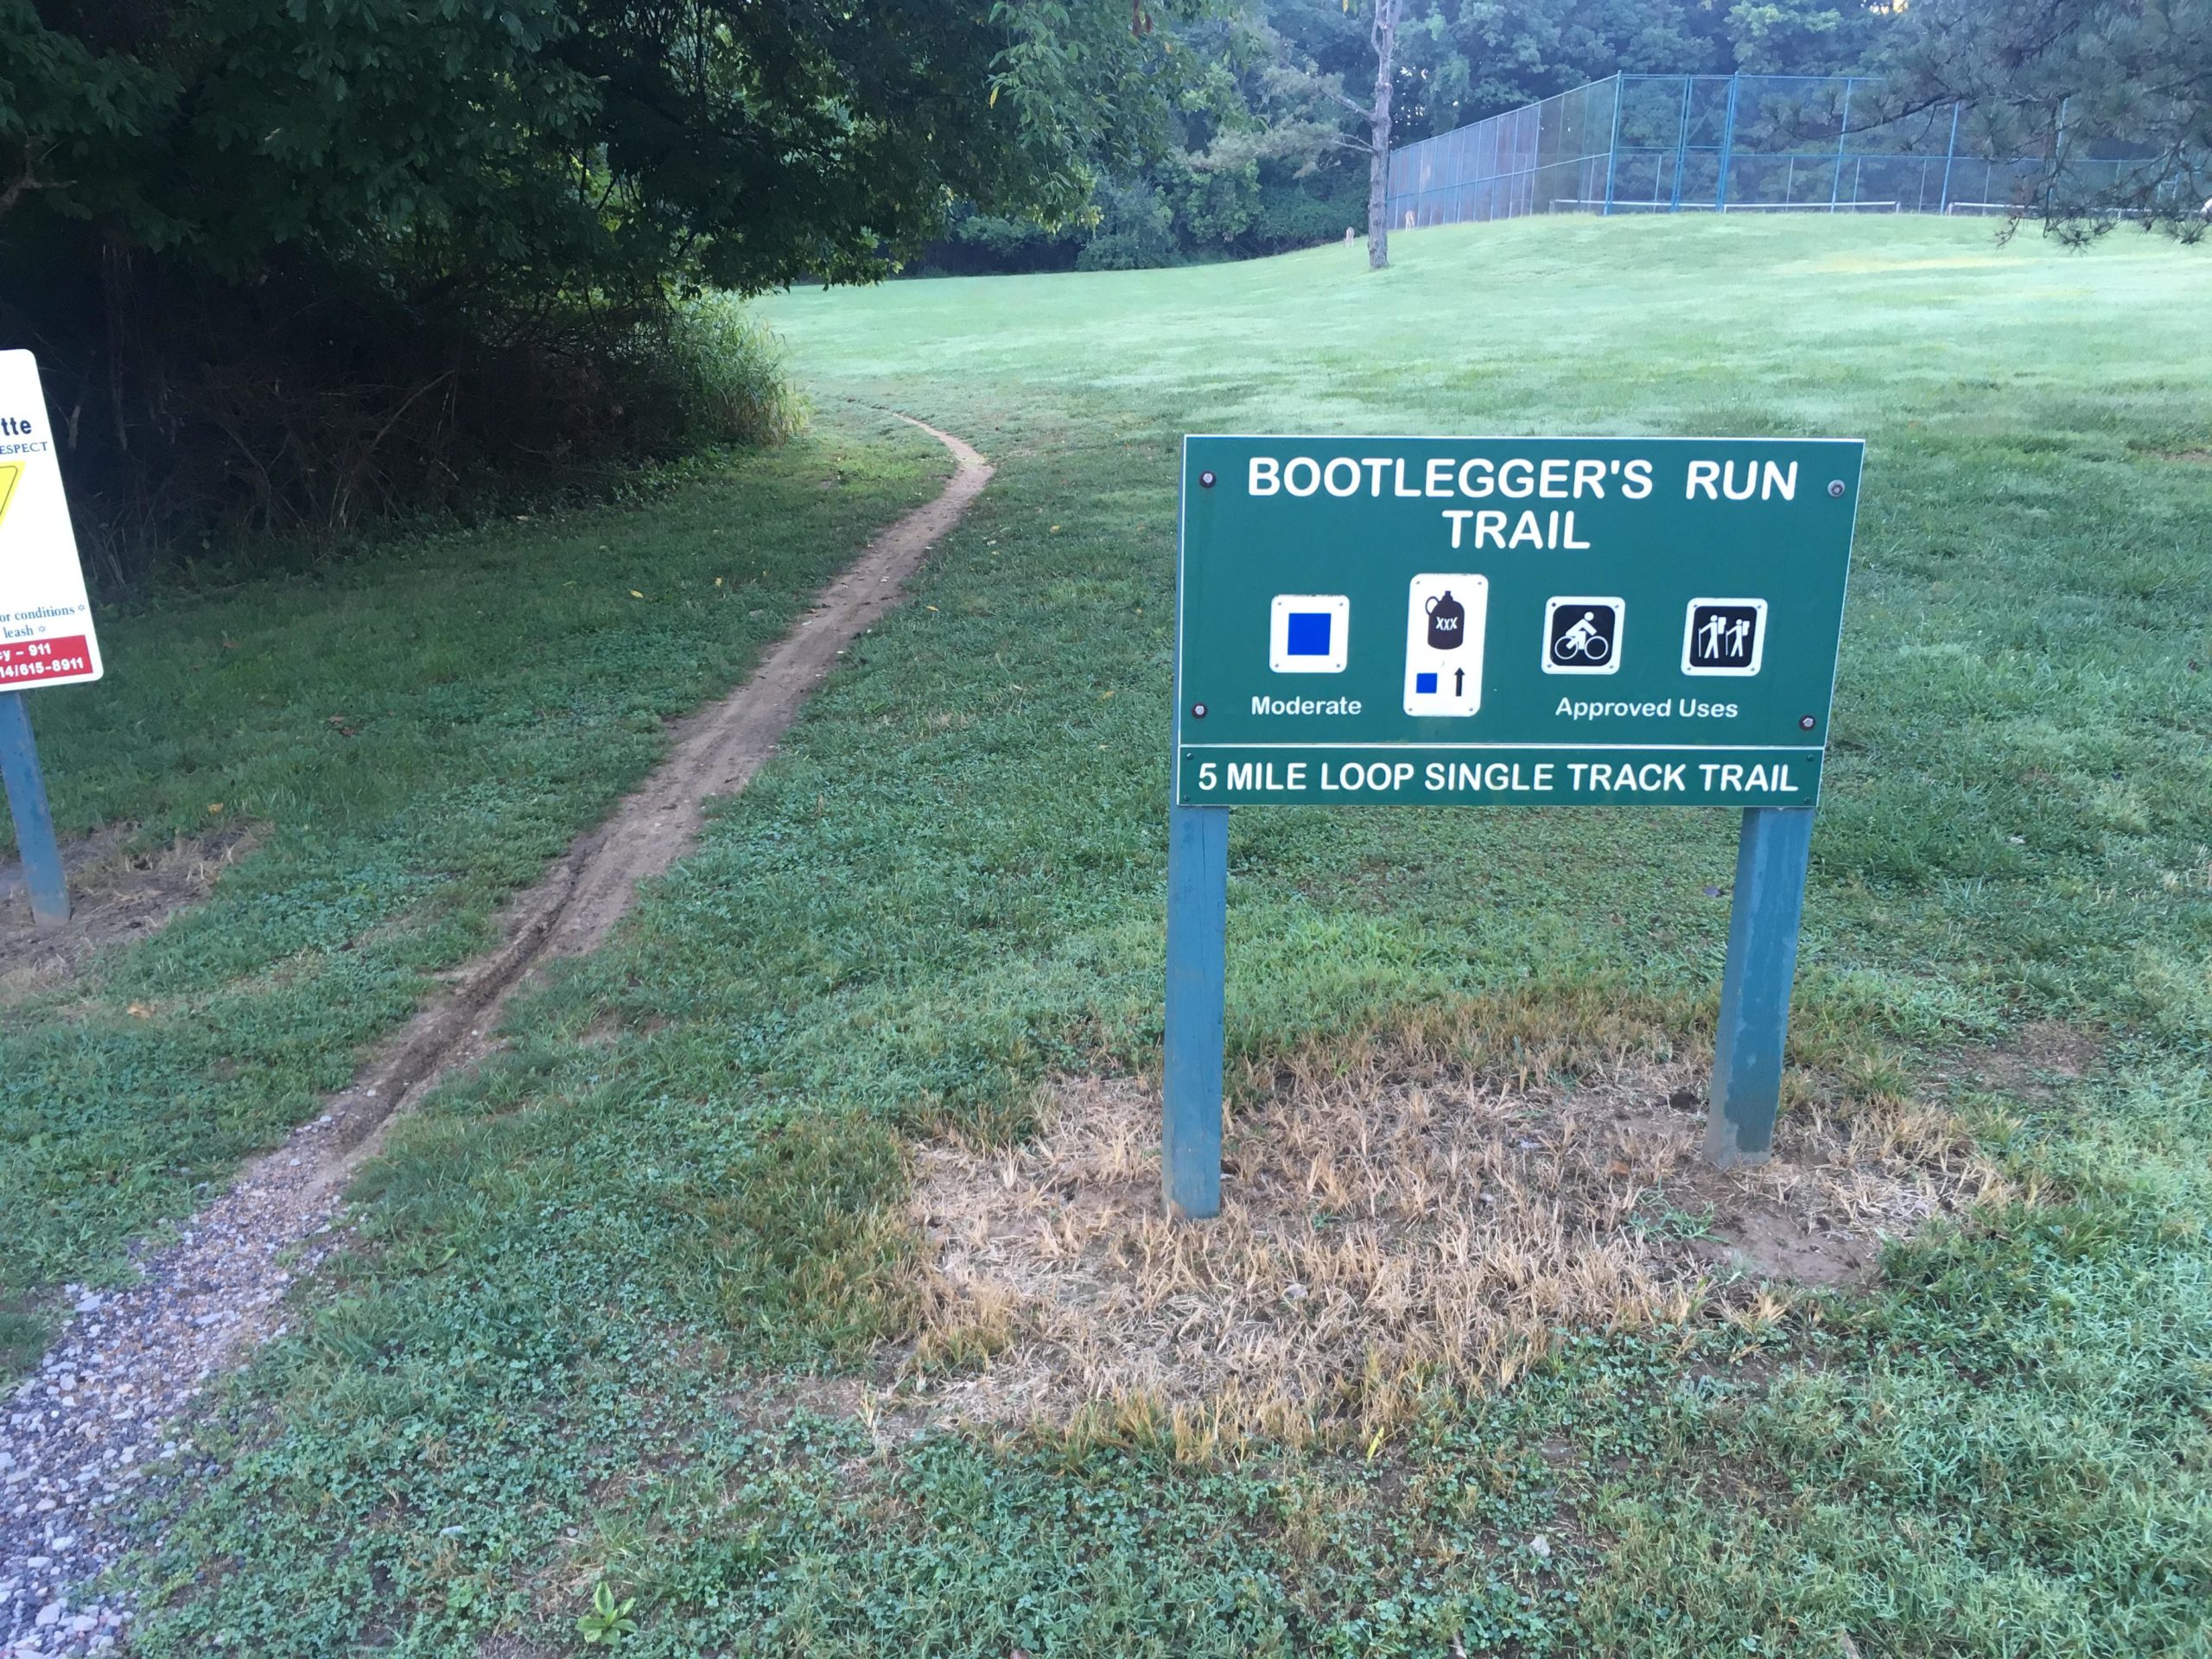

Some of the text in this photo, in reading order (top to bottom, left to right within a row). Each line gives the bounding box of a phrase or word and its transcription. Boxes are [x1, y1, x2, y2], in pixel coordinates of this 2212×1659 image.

[1, 417, 32, 436] tte
[0, 441, 48, 454] ESPECT
[1248, 456, 1799, 501] BOOTLEGGER'S RUN
[1441, 509, 1591, 550] TRAIL
[14, 606, 75, 621] conditions
[3, 625, 34, 639] leash
[28, 643, 52, 657] 911
[1251, 696, 1362, 716] Moderate
[1555, 696, 1738, 721] Approved Uses
[1198, 762, 1799, 792] 5 MILE LOOP SINGLE TRACK TRAIL
